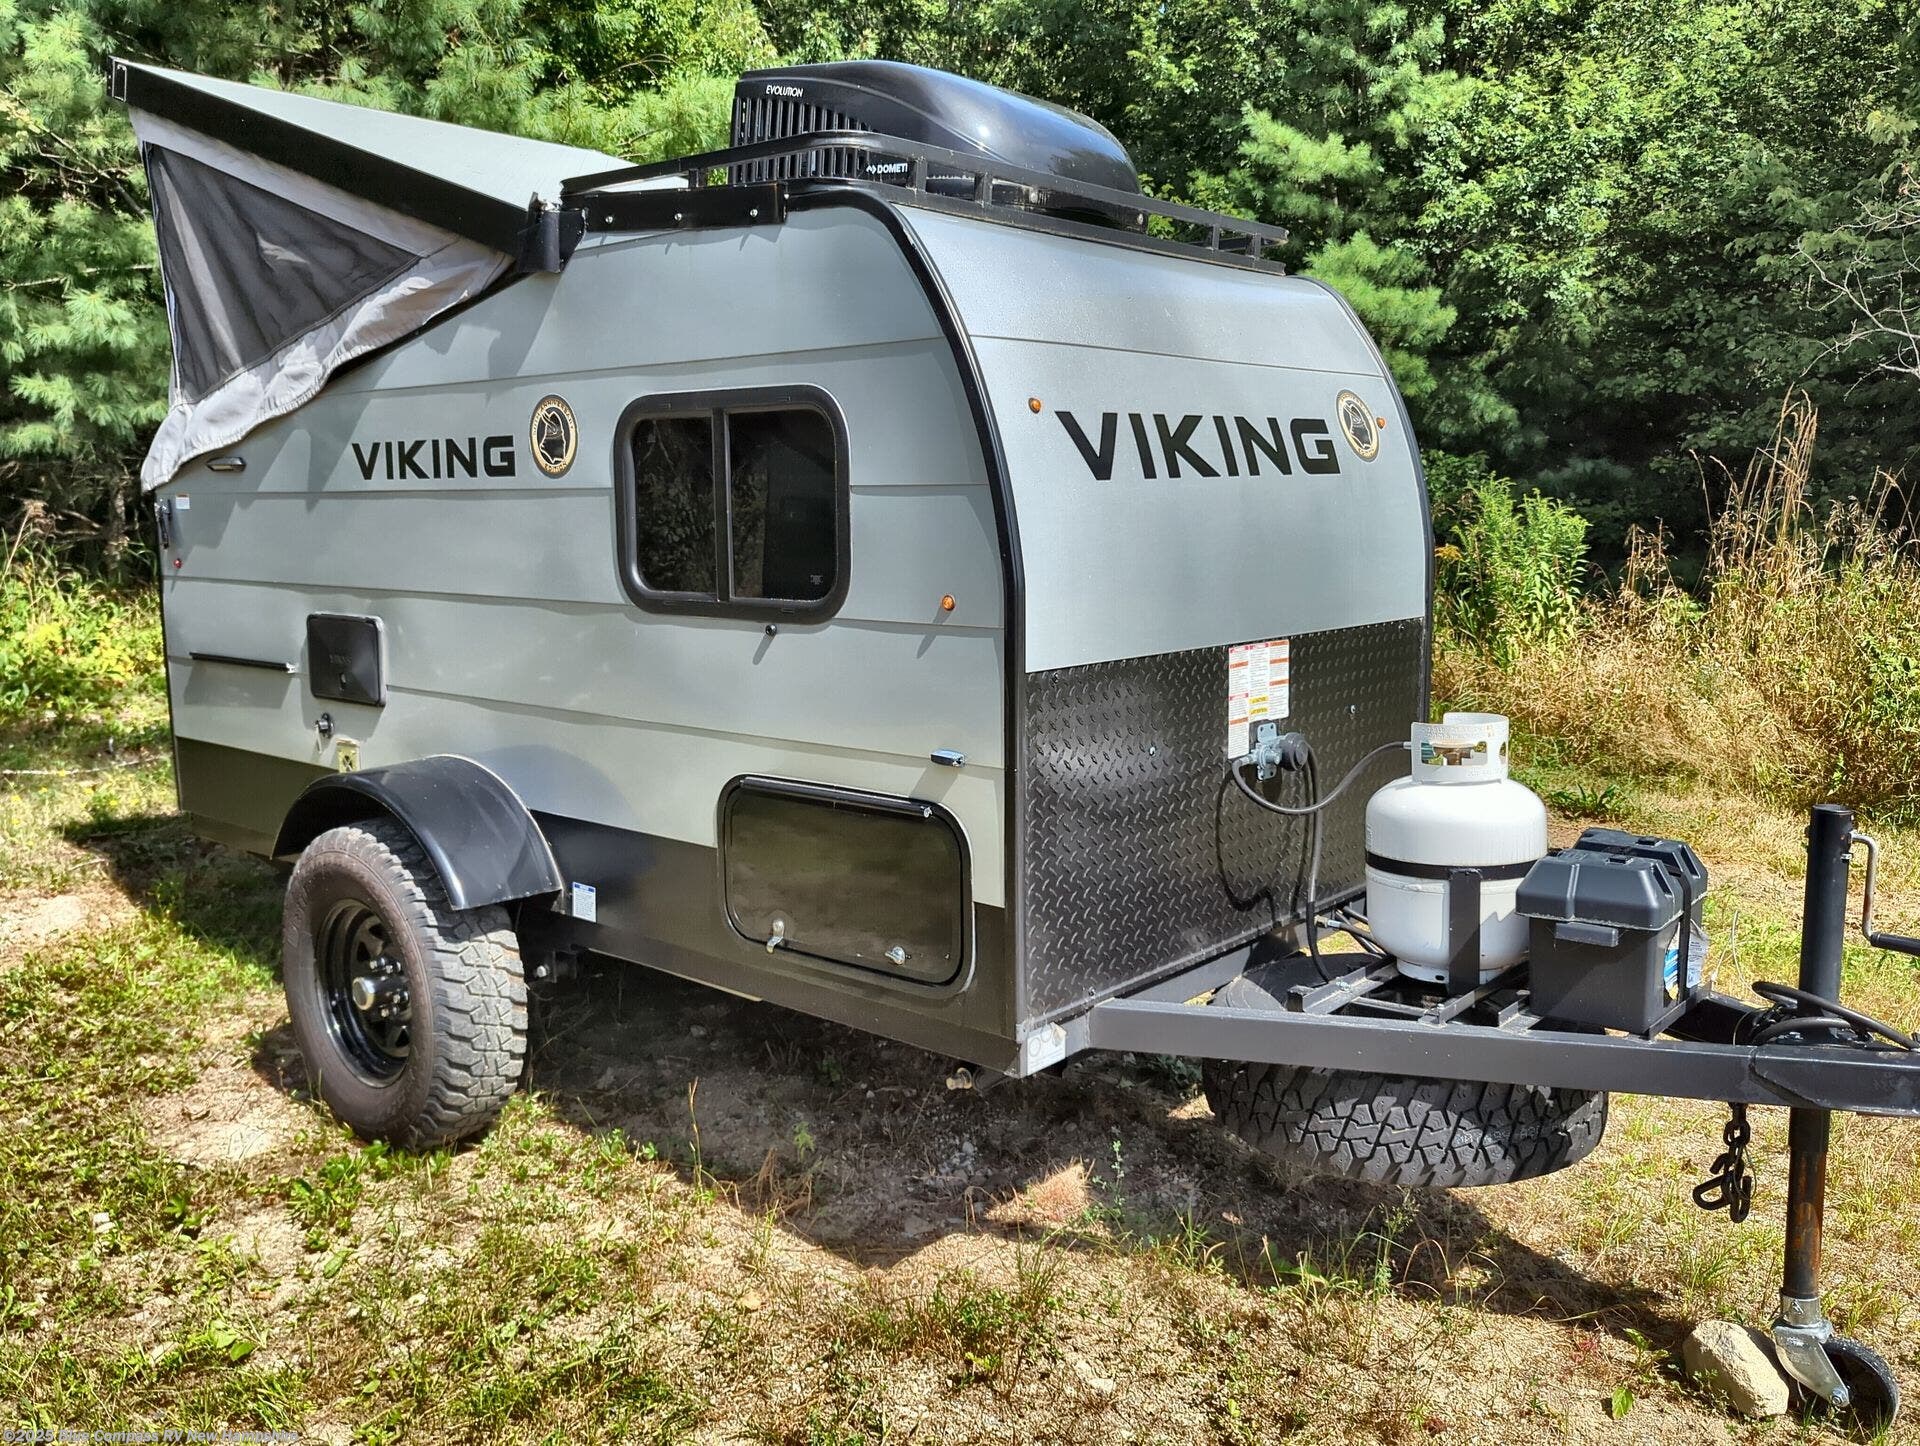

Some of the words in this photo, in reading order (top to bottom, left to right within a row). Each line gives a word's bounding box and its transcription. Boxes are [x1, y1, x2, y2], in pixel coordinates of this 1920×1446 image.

[766, 84, 804, 98] EVOLUTION
[876, 162, 908, 174] DOMETI
[351, 434, 516, 481] VIKING
[1054, 410, 1341, 481] VIKING
